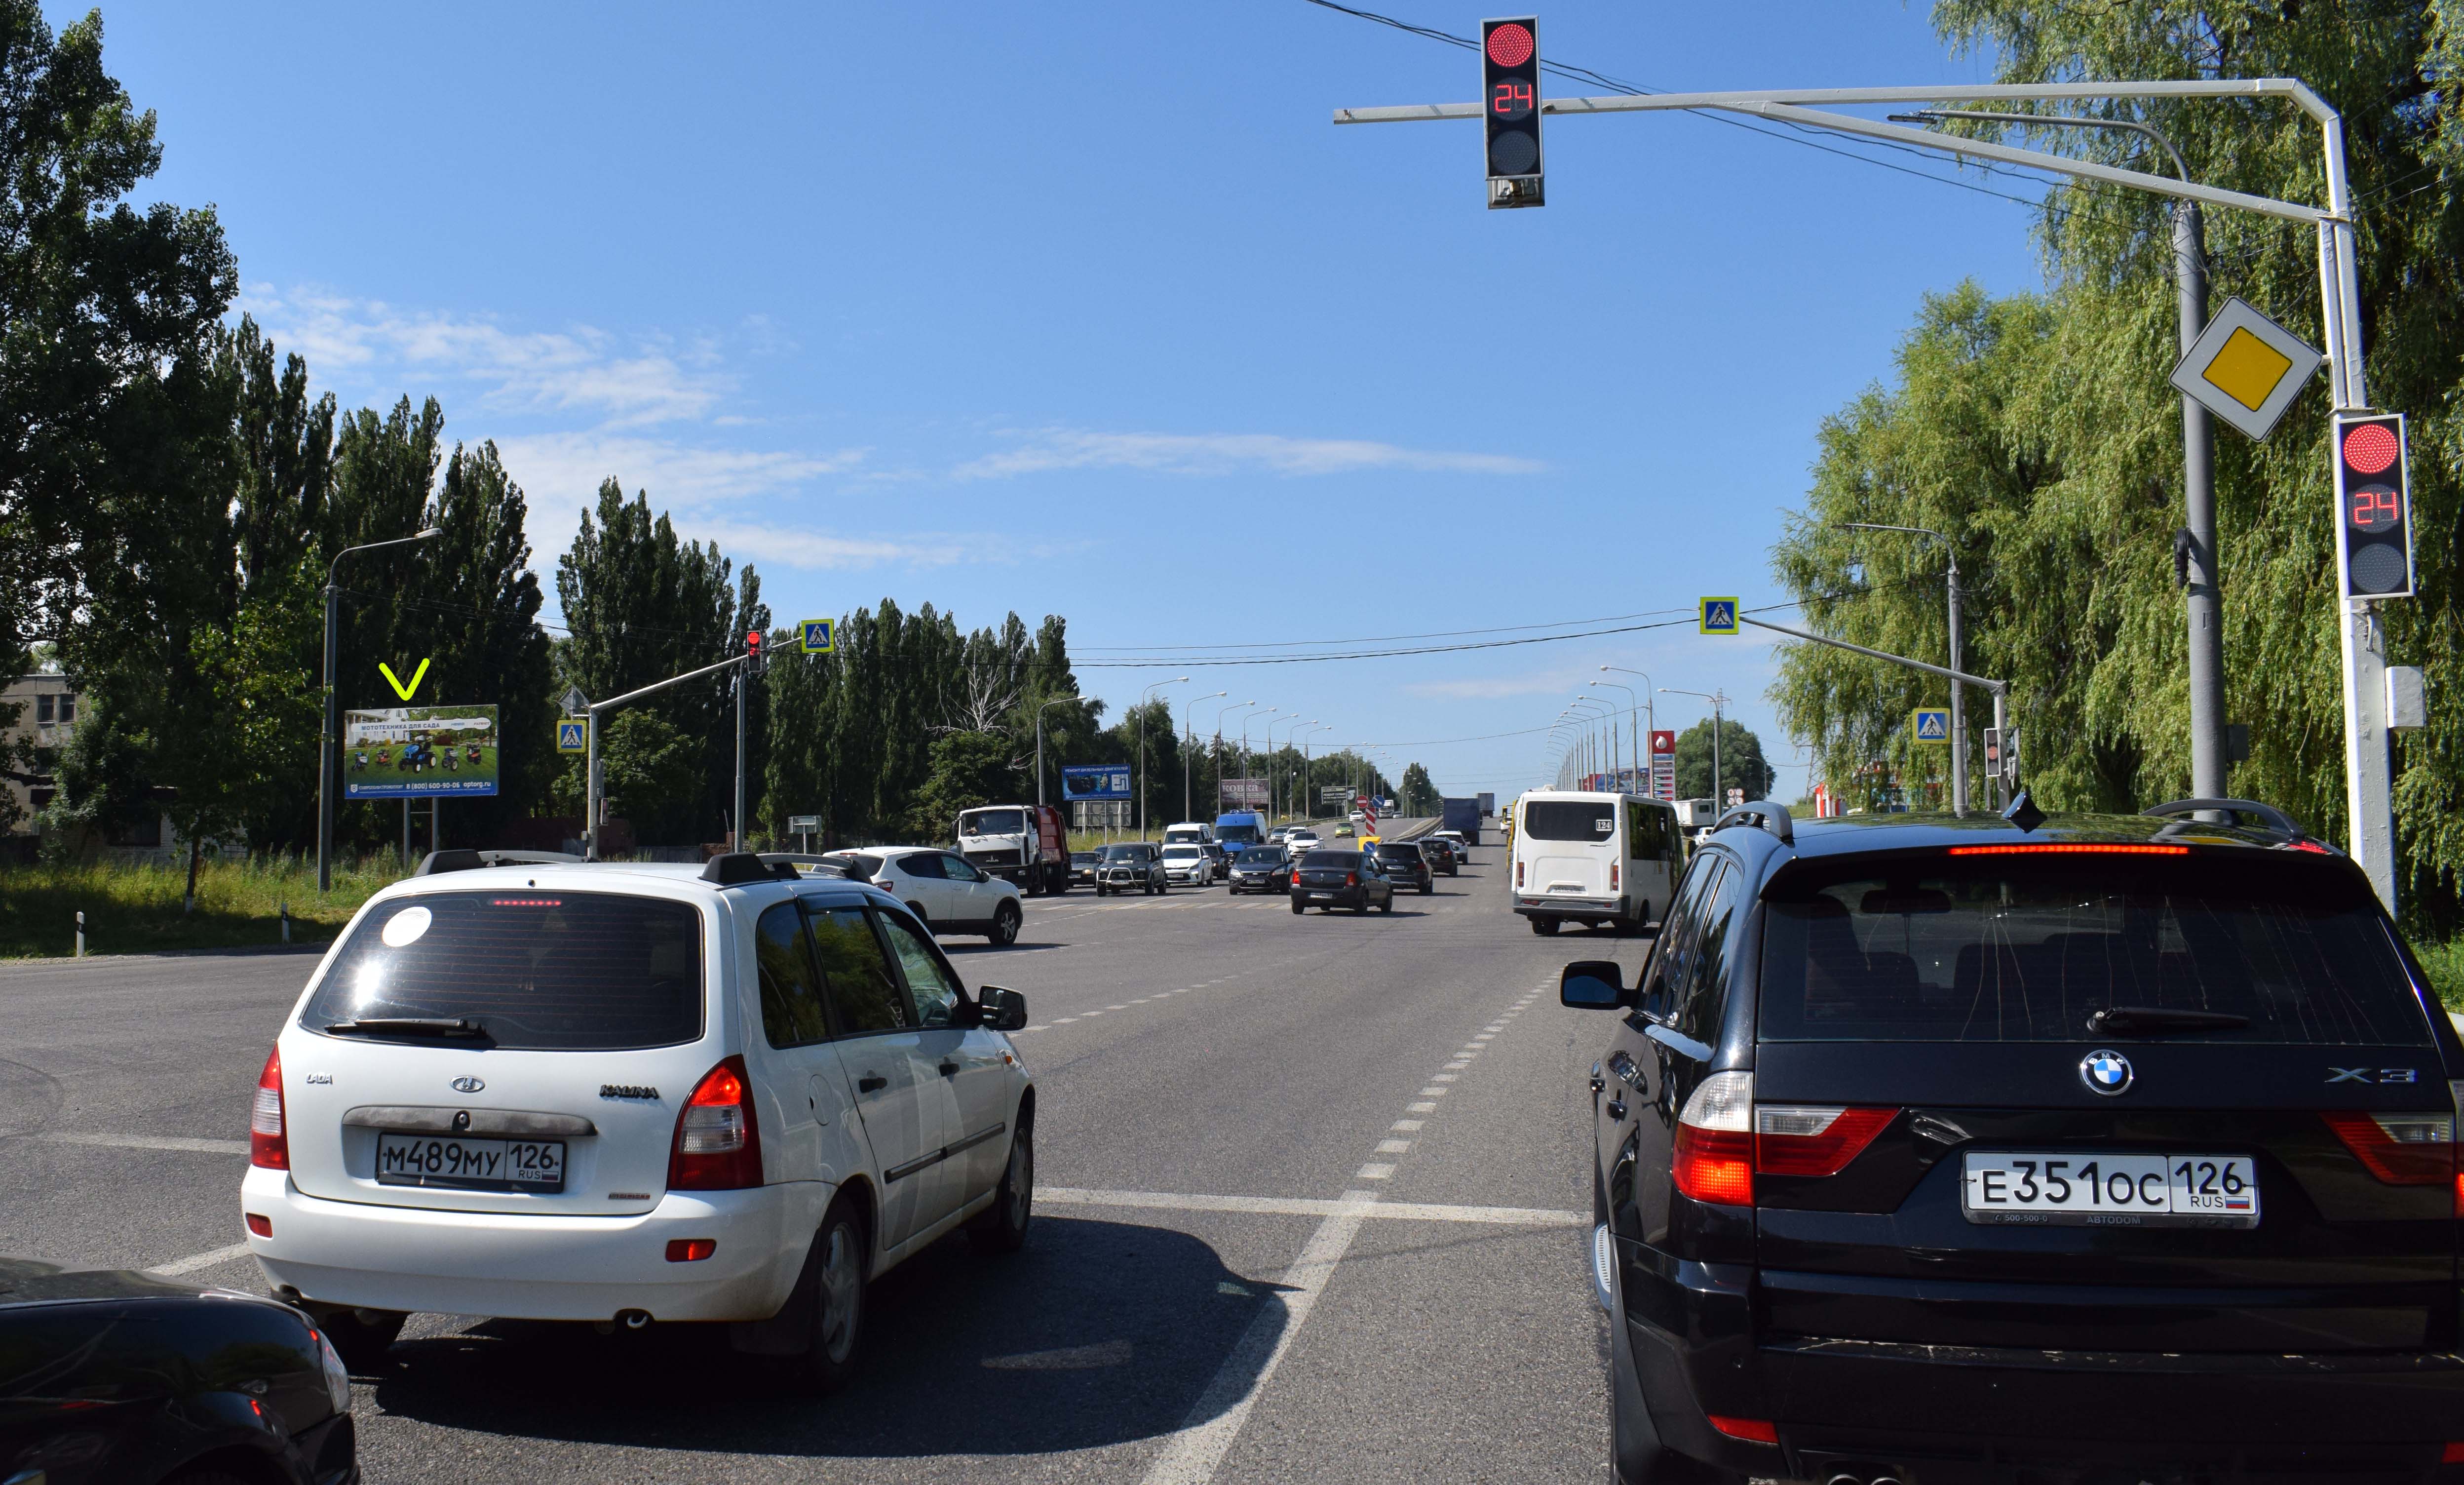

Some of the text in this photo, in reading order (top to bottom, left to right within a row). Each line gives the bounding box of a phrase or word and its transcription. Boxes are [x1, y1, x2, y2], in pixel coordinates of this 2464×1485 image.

[1495, 84, 1532, 112] 24
[2354, 492, 2397, 524] 24
[307, 1073, 333, 1085] LADA
[2324, 1067, 2415, 1083] X3
[599, 1085, 659, 1099] KALINA
[510, 1144, 554, 1170] 126
[519, 1170, 541, 1179] RUS
[2175, 1162, 2243, 1195] 126
[2191, 1196, 2224, 1208] RUS
